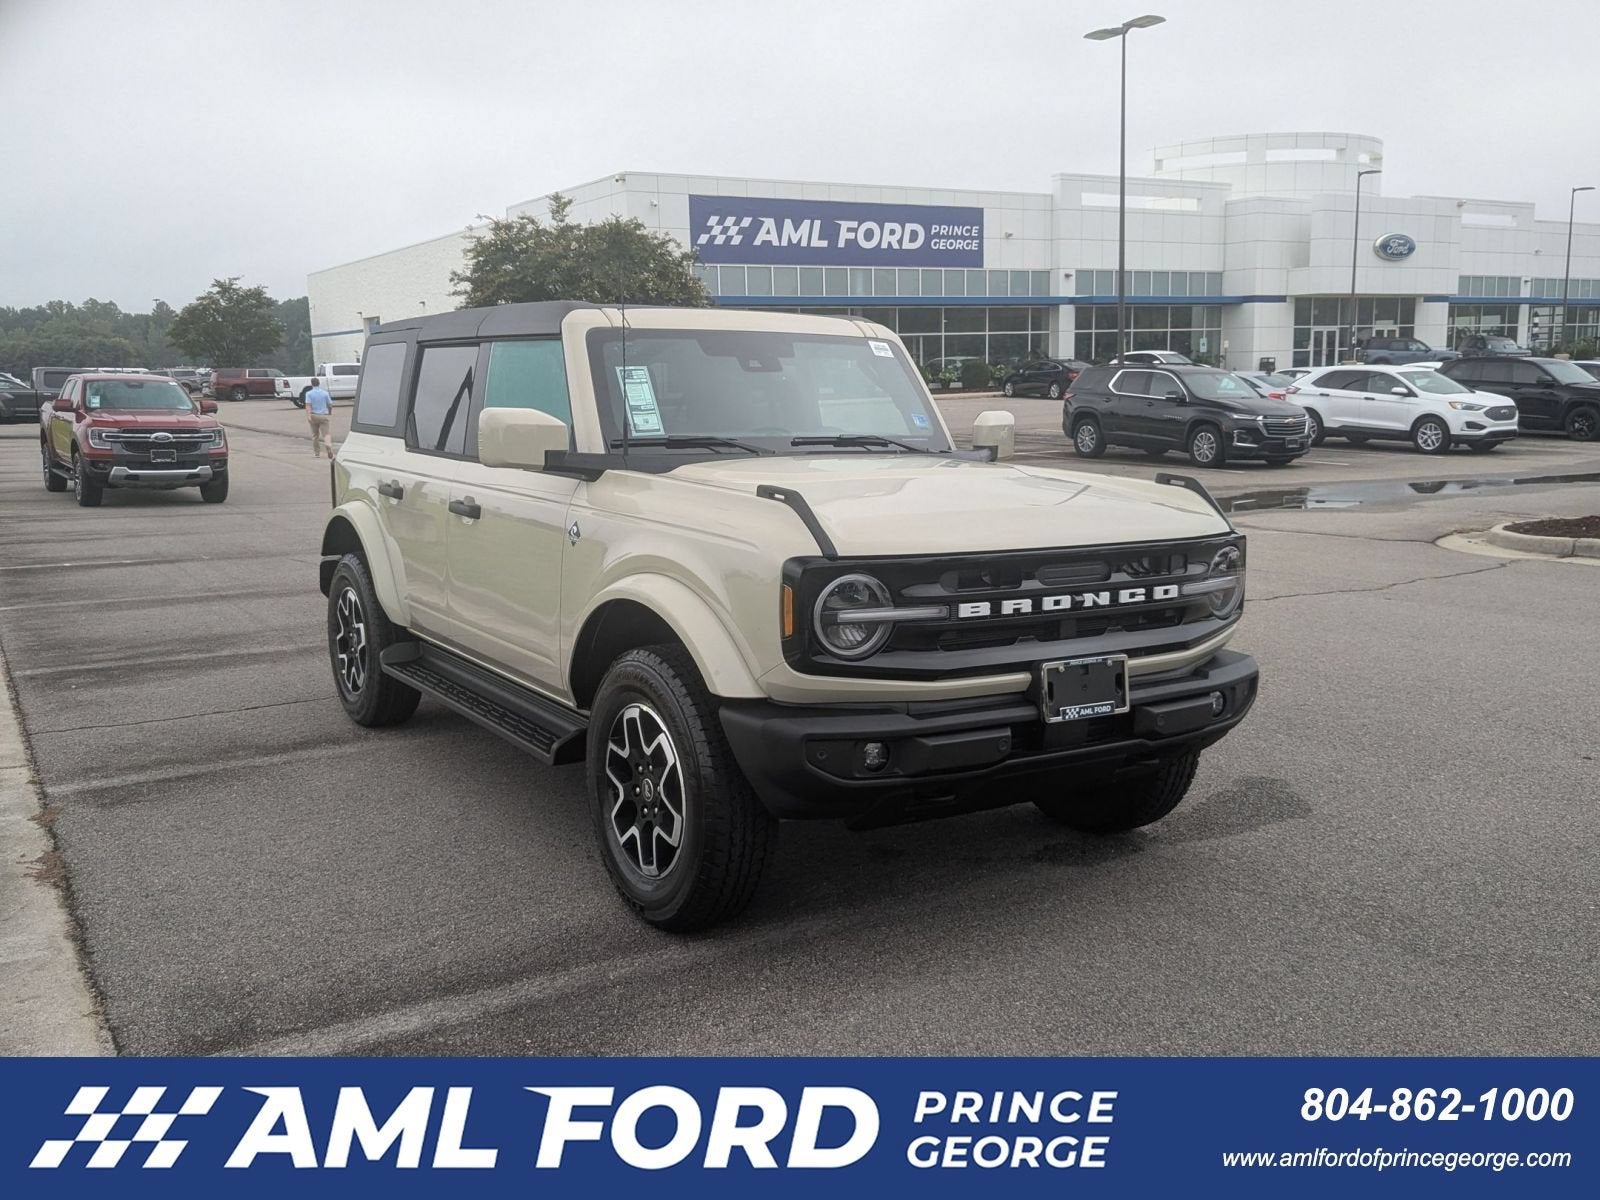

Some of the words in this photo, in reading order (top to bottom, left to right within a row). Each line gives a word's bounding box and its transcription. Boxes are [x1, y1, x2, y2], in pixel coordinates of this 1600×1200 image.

[753, 217, 828, 248] AML
[834, 220, 925, 250] FORD
[930, 224, 979, 237] PRINCE
[930, 239, 979, 251] GEORGE
[1386, 238, 1410, 254] Ford
[958, 584, 1178, 618] BRONCO
[1080, 708, 1094, 716] AML
[1094, 705, 1112, 714] FORD
